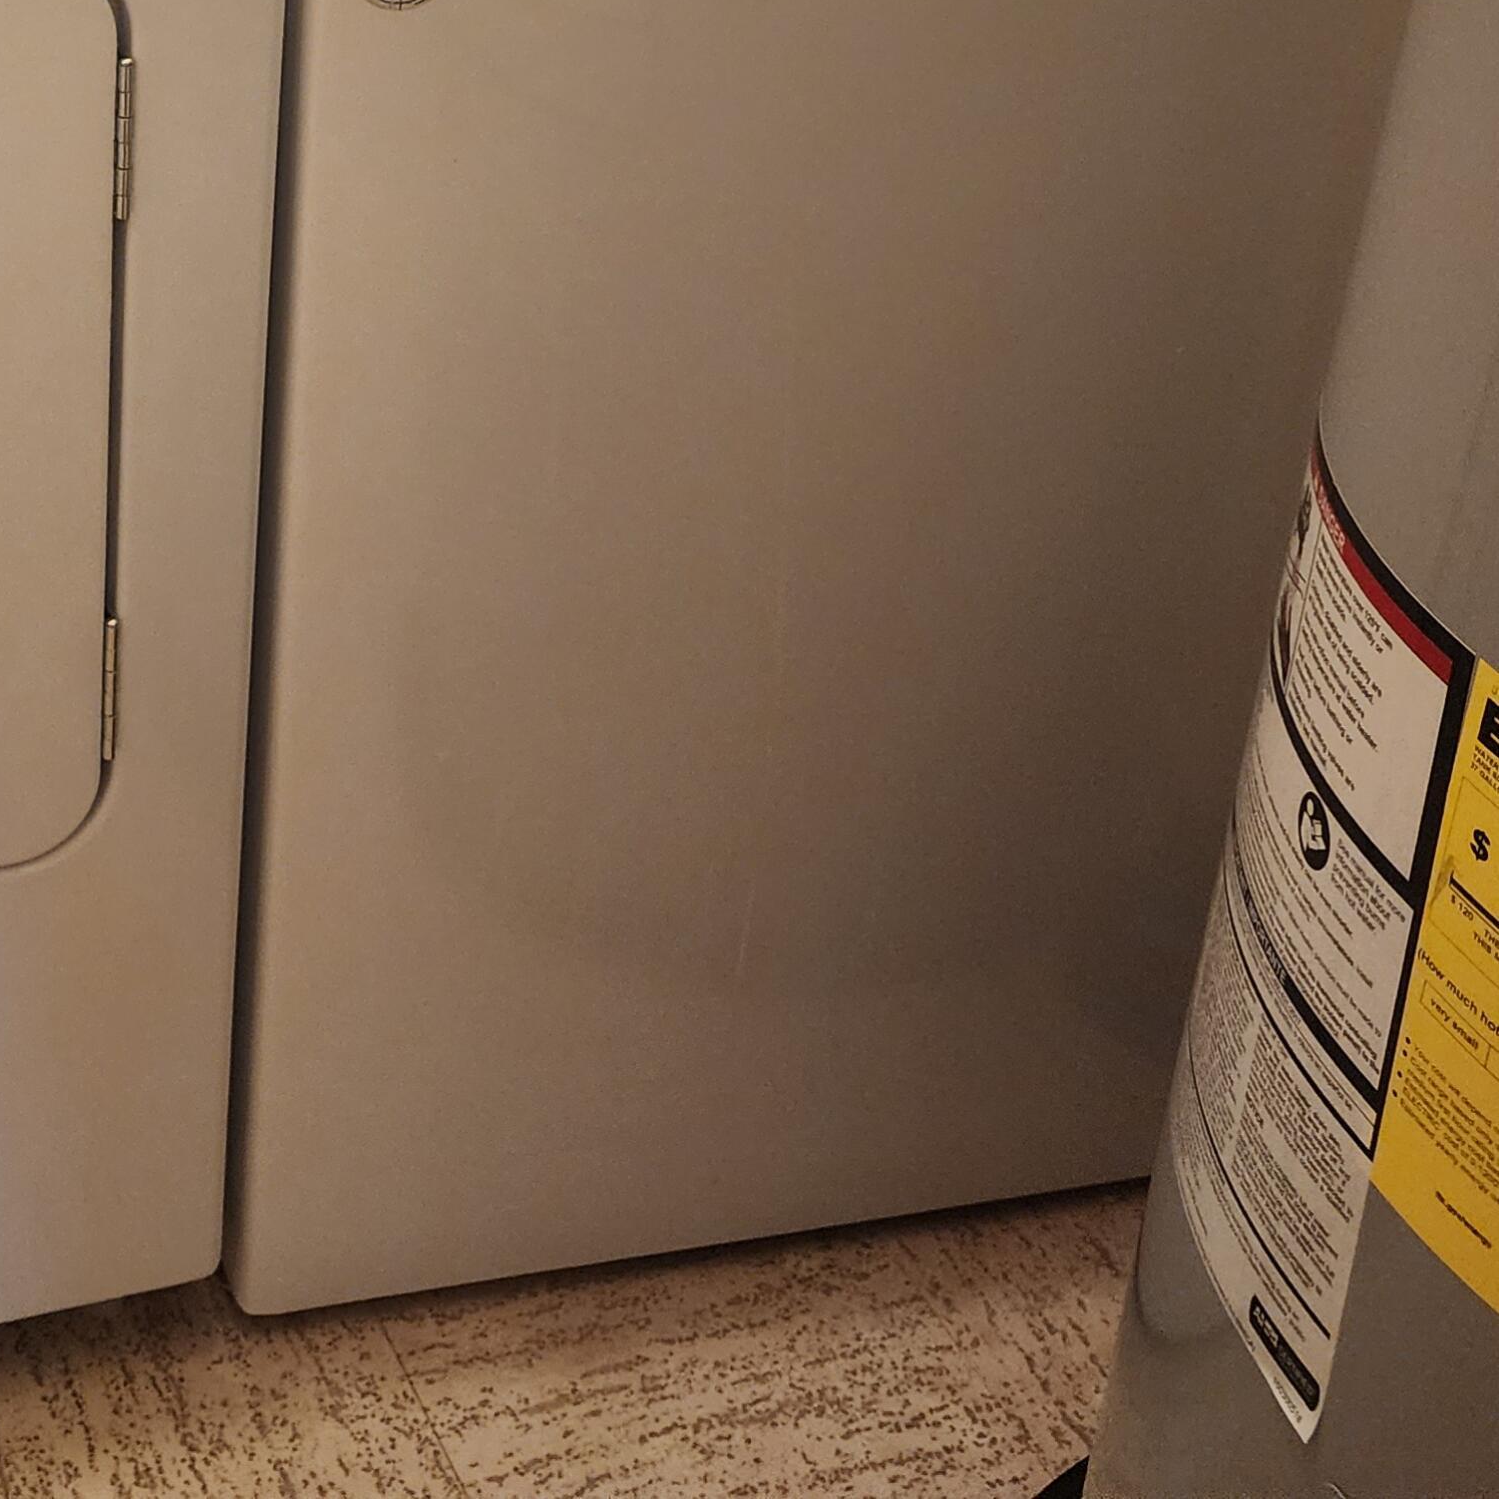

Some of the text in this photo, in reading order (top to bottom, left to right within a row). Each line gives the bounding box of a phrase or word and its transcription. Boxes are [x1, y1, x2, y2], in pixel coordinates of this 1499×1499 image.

[1470, 828, 1491, 862] $
[1417, 947, 1445, 980] (How
[1446, 979, 1478, 1016] much
[1430, 997, 1480, 1050] very small
